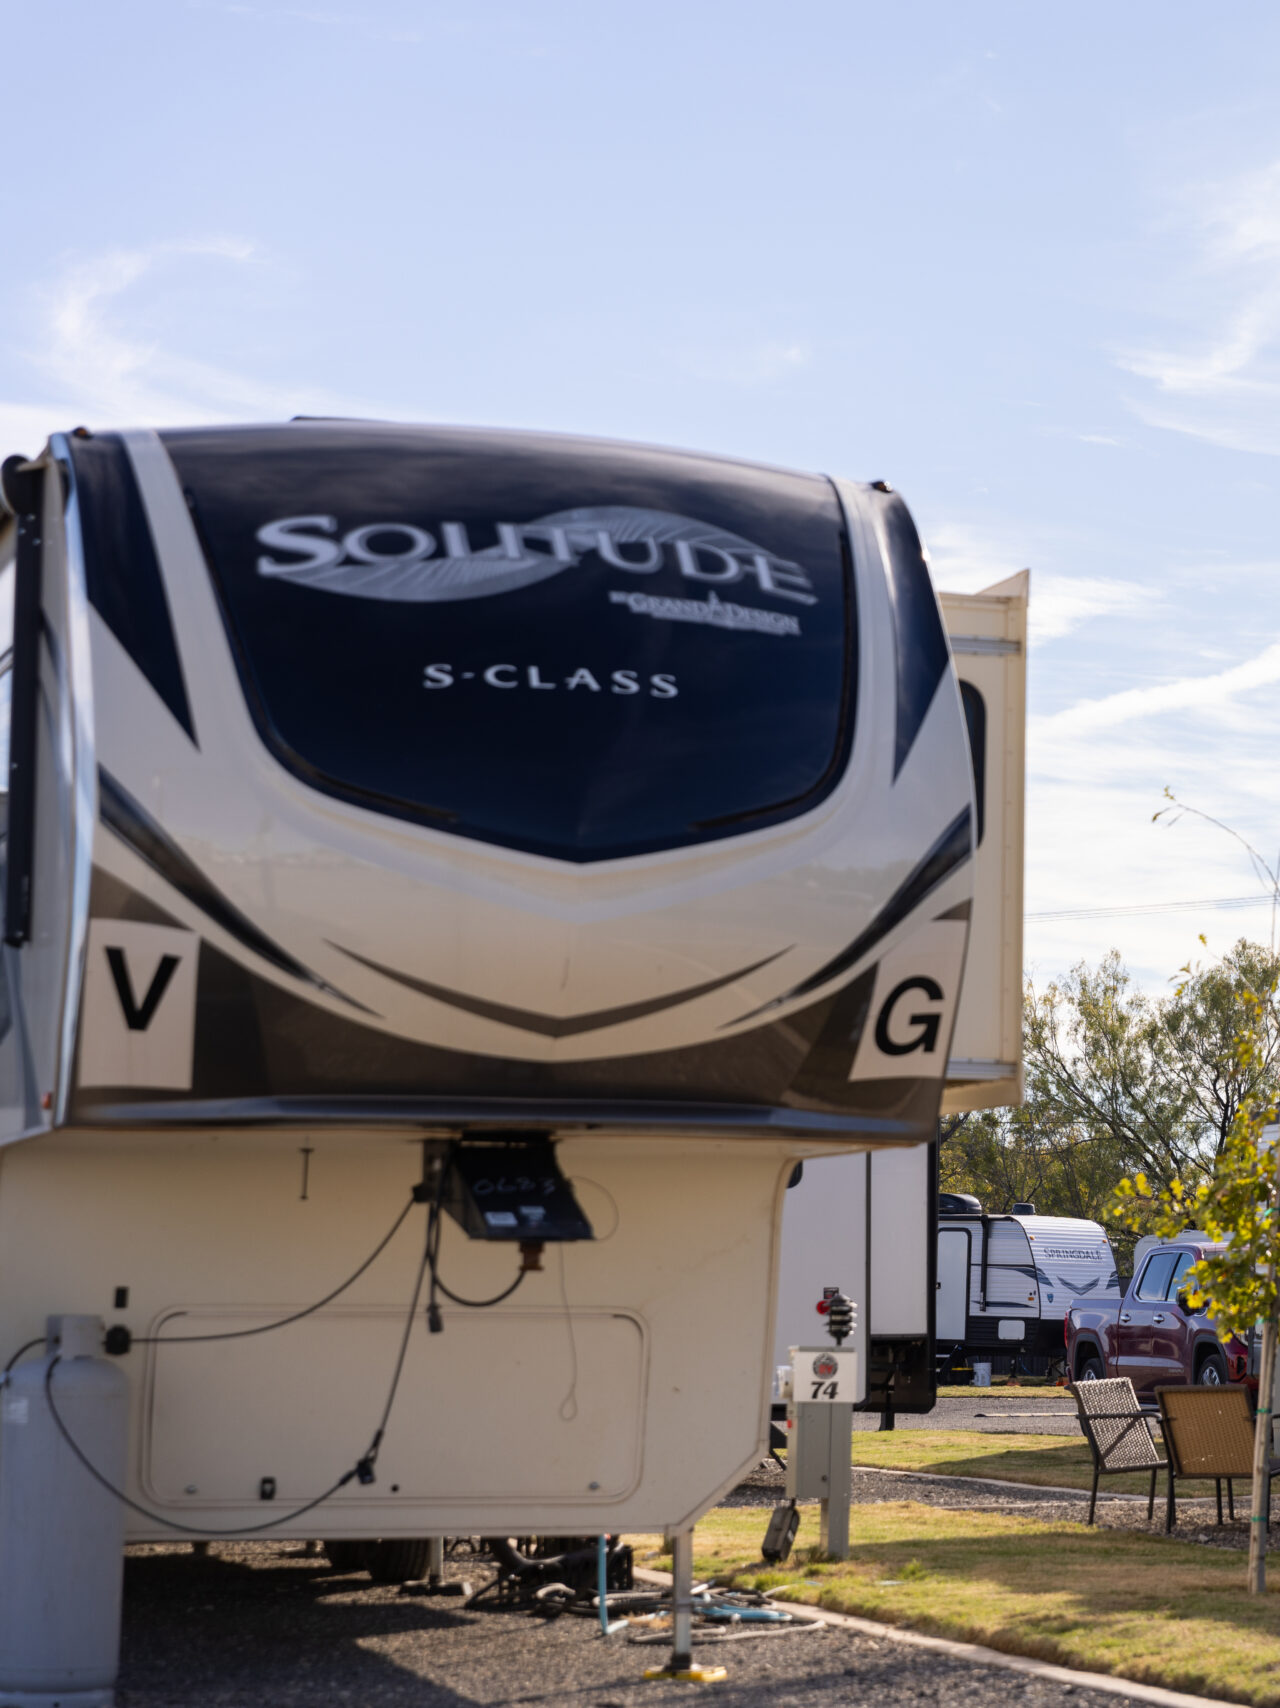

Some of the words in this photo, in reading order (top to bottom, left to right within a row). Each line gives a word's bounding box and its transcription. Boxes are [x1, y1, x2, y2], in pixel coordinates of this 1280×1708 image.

[256, 514, 818, 606] SOLITUDE
[422, 662, 680, 699] S-CLASS
[104, 945, 182, 1034] V
[872, 974, 946, 1058] G
[1043, 1247, 1102, 1260] SPRINGDALE
[810, 1380, 839, 1400] 74
